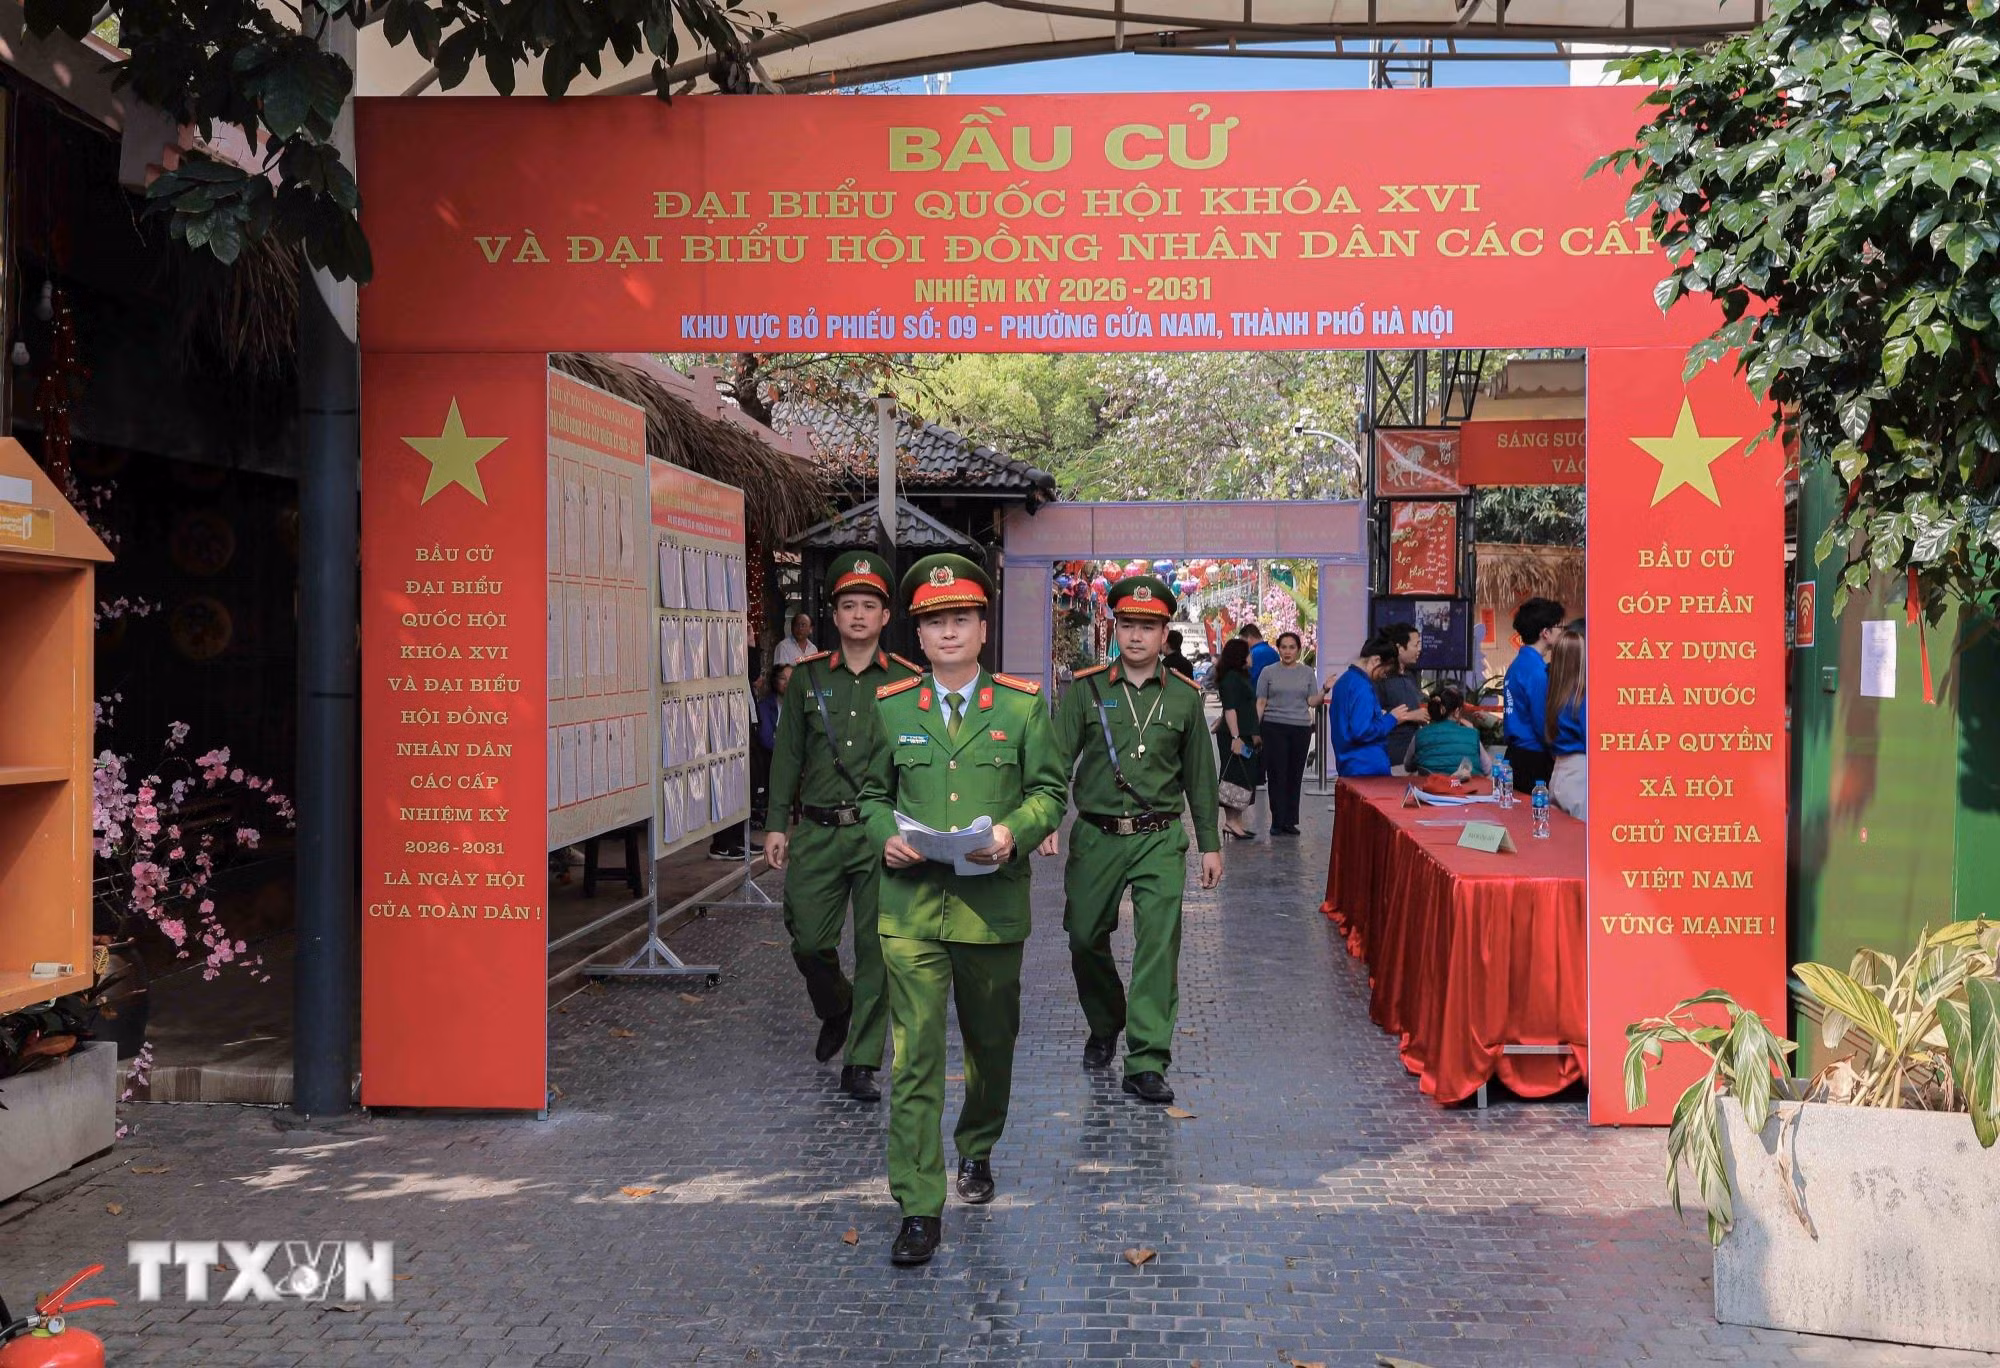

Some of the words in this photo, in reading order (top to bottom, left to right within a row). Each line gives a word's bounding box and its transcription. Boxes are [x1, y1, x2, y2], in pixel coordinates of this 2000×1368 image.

[889, 106, 1074, 173] BẦU
[1104, 102, 1240, 171] CỬ
[653, 191, 751, 225] ĐẠI
[768, 177, 898, 219] BIỂU
[914, 179, 1066, 222] QUỐC
[1081, 181, 1183, 223] HỘI
[1199, 178, 1362, 215] KHÓA
[1377, 184, 1481, 213] XVI
[473, 228, 551, 263] VÀ
[566, 235, 664, 269] ĐẠI
[680, 218, 810, 264] BIỂU
[826, 228, 926, 270] HỘI
[943, 222, 1103, 263] ĐỒNG
[1117, 225, 1282, 261] NHÂN
[1298, 223, 1421, 259] DÂN
[1436, 221, 1544, 257] CÁC
[915, 273, 1006, 309] NHIỆM
[1015, 273, 1051, 303] KỲ
[1059, 277, 1127, 302] 2026
[1146, 276, 1211, 301] 2031
[681, 314, 728, 339] KHU
[734, 312, 781, 344] VỰC
[788, 306, 819, 339] BỎ
[826, 307, 895, 340] PHIẾU
[902, 306, 941, 340] SỐ:
[948, 315, 977, 339] 09
[1001, 308, 1098, 339] PHƯỜNG
[1105, 305, 1153, 338] CỬA
[1160, 312, 1223, 340] NAM,
[1230, 307, 1309, 337] THÀNH
[1316, 302, 1366, 336] PHỐ
[1372, 305, 1405, 335] HÀ
[1412, 304, 1453, 340] NỘI
[1497, 430, 1550, 449] SÁNG
[415, 542, 460, 562] BẦU
[465, 543, 494, 562] CỬ
[1638, 541, 1693, 568] BẦU
[1700, 543, 1735, 568] CỬ
[405, 580, 445, 597] ĐẠI
[451, 575, 503, 595] BIỂU
[1617, 590, 1672, 614] GÓP
[1679, 587, 1754, 614] PHẦN
[401, 608, 461, 628] QUỐC
[467, 610, 507, 630] HỘI
[400, 642, 463, 659] KHÓA
[468, 646, 509, 660] XVI
[1615, 637, 1674, 660] XÂY
[1681, 641, 1757, 664] DỰNG
[387, 674, 418, 692] VÀ
[423, 678, 463, 695] ĐẠI
[469, 673, 521, 693] BIỂU
[1617, 682, 1676, 705] NHÀ
[1682, 682, 1756, 706] NƯỚC
[400, 707, 440, 727] HỘI
[446, 705, 509, 725] ĐỒNG
[396, 740, 460, 757] NHÂN
[465, 740, 513, 758] DÂN
[1599, 729, 1671, 751] PHÁP
[1678, 725, 1774, 753] QUYỀN
[410, 772, 452, 789] CÁC
[457, 771, 499, 790] CẤP
[1639, 775, 1678, 797] XÃ
[1685, 774, 1734, 801] HỘI
[399, 804, 473, 824] NHIỆM
[478, 805, 510, 822] KỲ
[1611, 818, 1666, 843] CHỦ
[1673, 821, 1762, 843] NGHĨA
[405, 840, 450, 854] 2026
[462, 841, 505, 855] 2031
[383, 868, 413, 886] LÀ
[417, 869, 480, 887] NGÀY
[485, 870, 526, 890] HỘI
[1621, 866, 1685, 892] VIỆT
[1691, 870, 1754, 889] NAM
[369, 899, 412, 918] CỦA
[417, 901, 478, 919] TOÀN
[483, 903, 531, 920] DÂN
[1599, 912, 1675, 935] VỮNG
[1681, 916, 1763, 939] MẠNH
